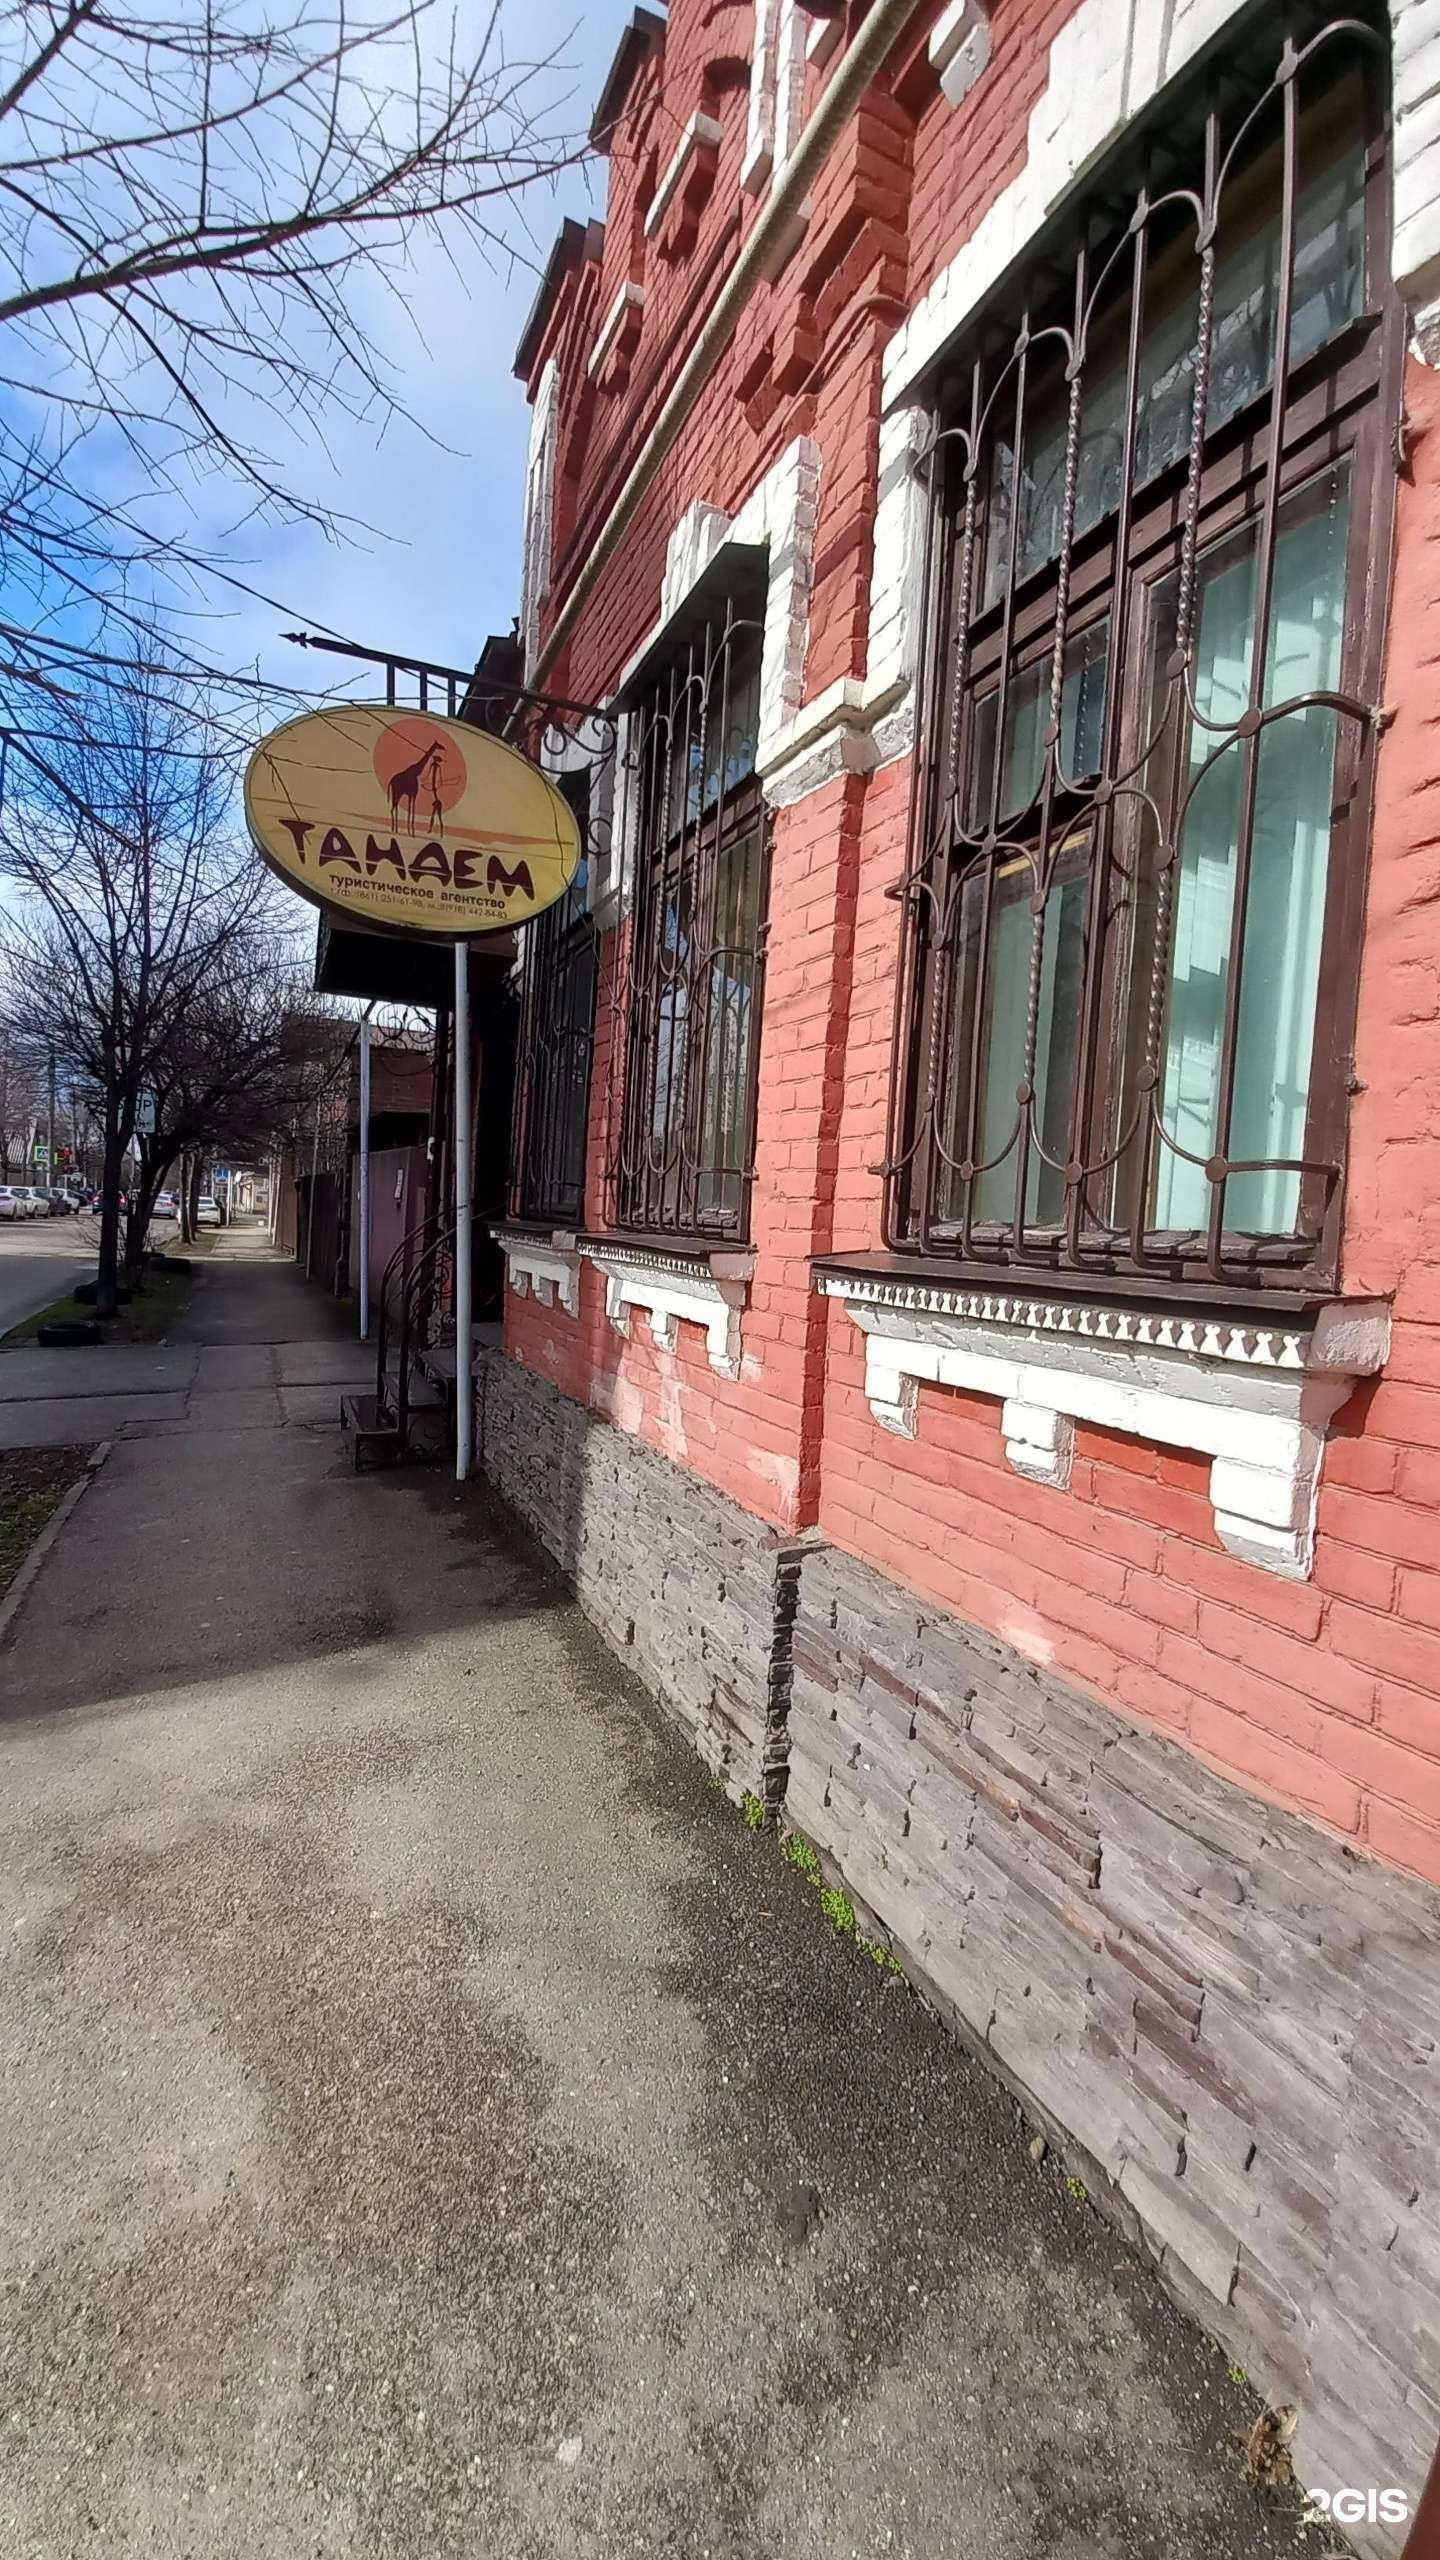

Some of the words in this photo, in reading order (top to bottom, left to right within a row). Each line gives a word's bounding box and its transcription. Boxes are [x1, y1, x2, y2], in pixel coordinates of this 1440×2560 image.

[279, 819, 536, 900] ТАНДЕМ
[329, 874, 434, 899] туристическое
[441, 891, 506, 909] агентство
